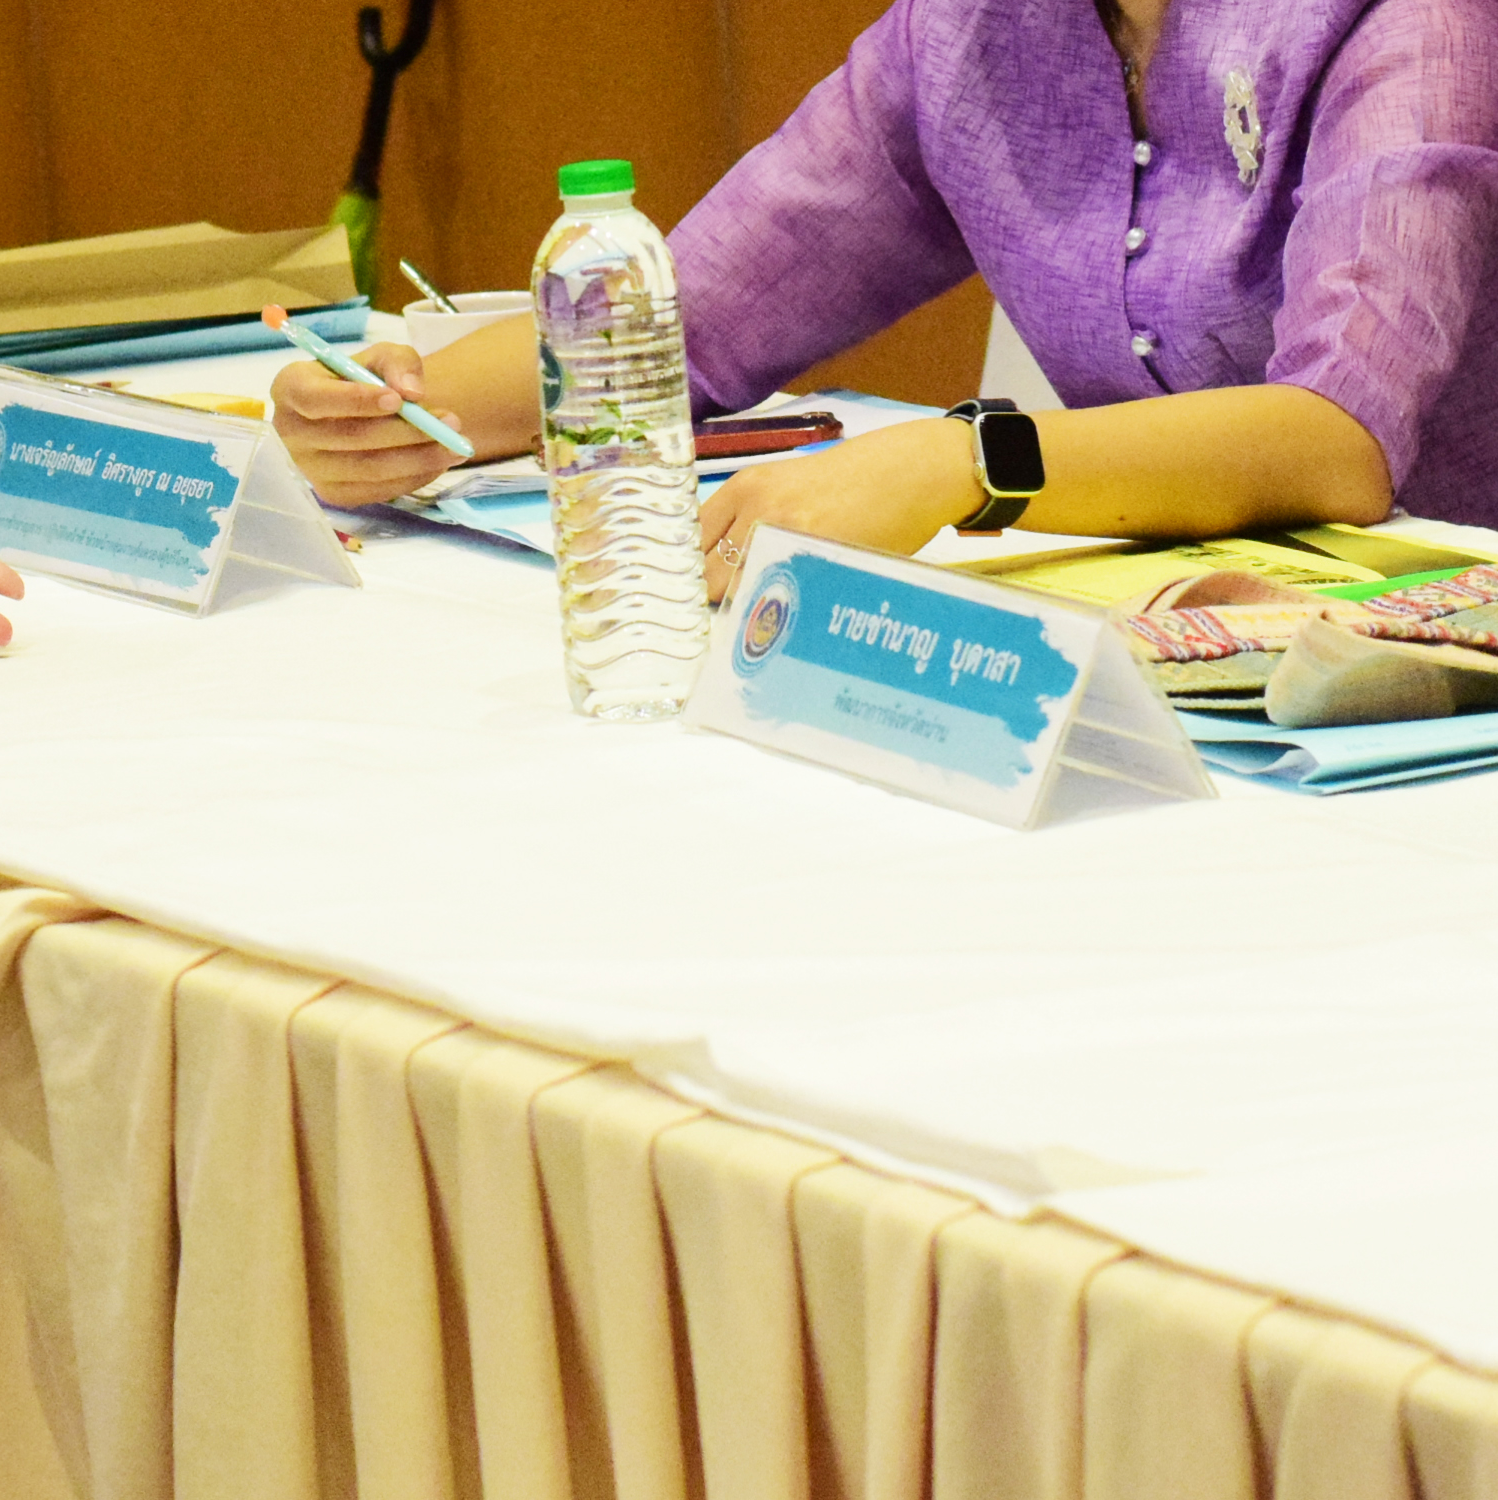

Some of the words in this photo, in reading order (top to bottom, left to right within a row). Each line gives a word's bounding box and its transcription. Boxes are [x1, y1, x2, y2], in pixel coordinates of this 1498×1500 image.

[10, 440, 102, 478] นางเจริญลักษณ์
[101, 453, 157, 496] อิศรางกูร
[155, 472, 171, 492] ณ
[172, 474, 215, 506] อยุธยา
[828, 600, 940, 675] นายชำนาญ
